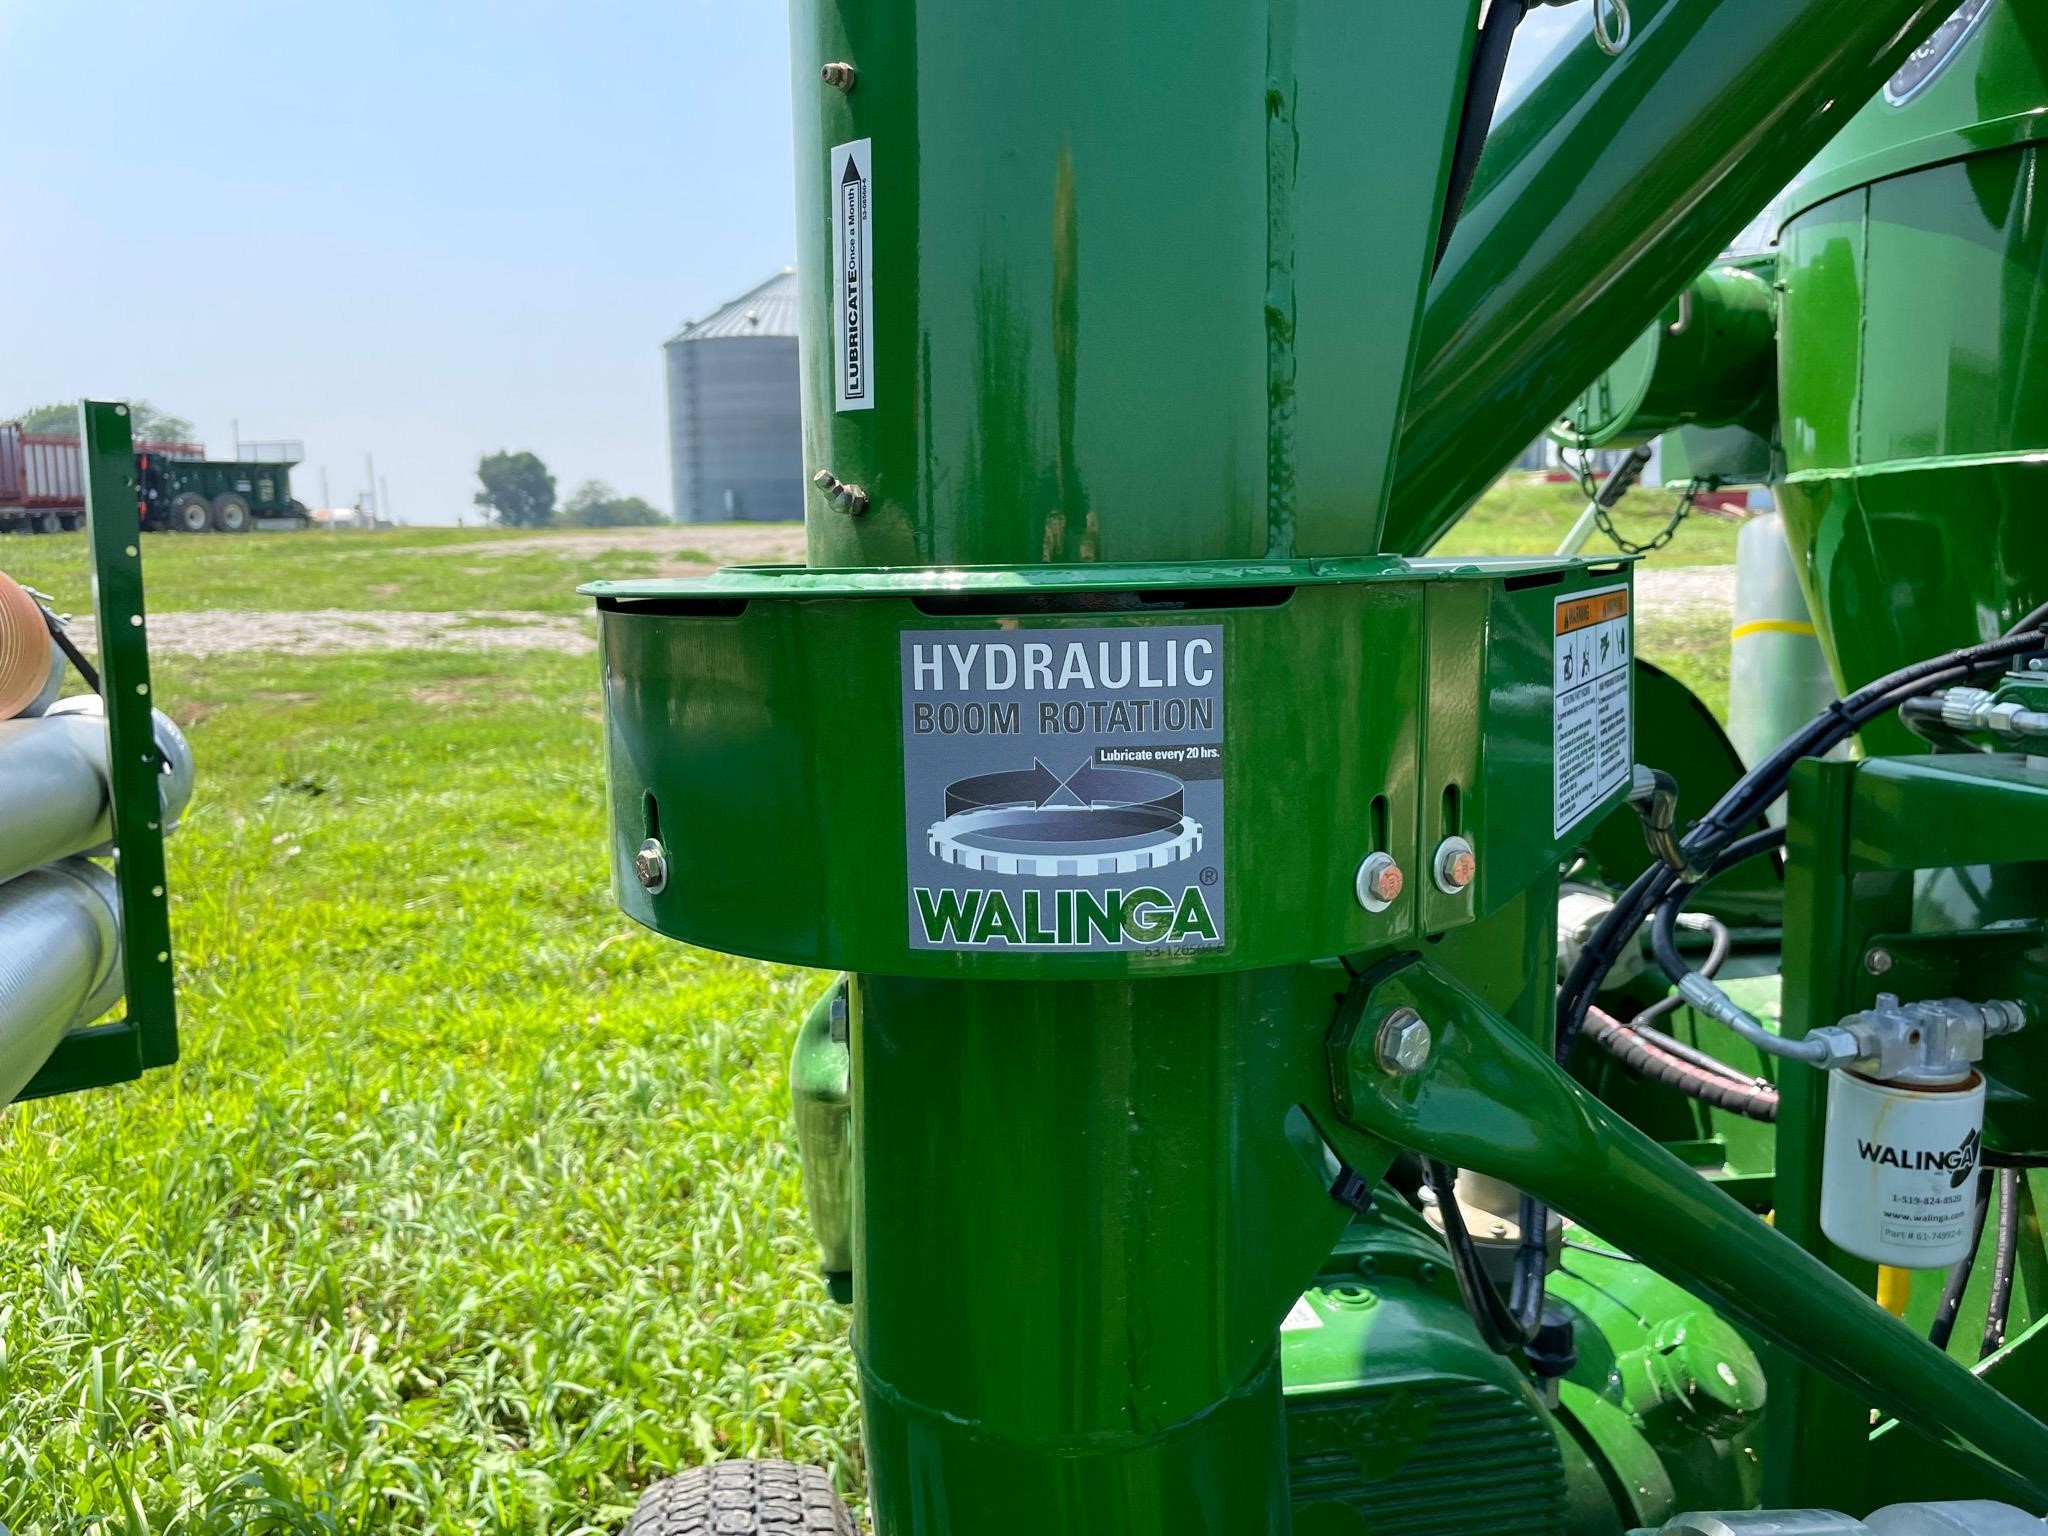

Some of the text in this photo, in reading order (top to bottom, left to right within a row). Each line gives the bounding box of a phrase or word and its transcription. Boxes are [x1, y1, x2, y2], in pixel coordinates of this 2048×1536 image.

[847, 188, 860, 390] LUBRICATE Once a Month
[912, 637, 1214, 692] HYDRAULIC
[912, 697, 1215, 735] BOOM ROTATION
[1100, 746, 1221, 762] Lubricate every 20 hrs.
[912, 885, 1221, 946] WALINGA
[1857, 1138, 1973, 1171] WALINGA
[1883, 1210, 1965, 1224] www.walinga.com
[1885, 1228, 1906, 1240] Part
